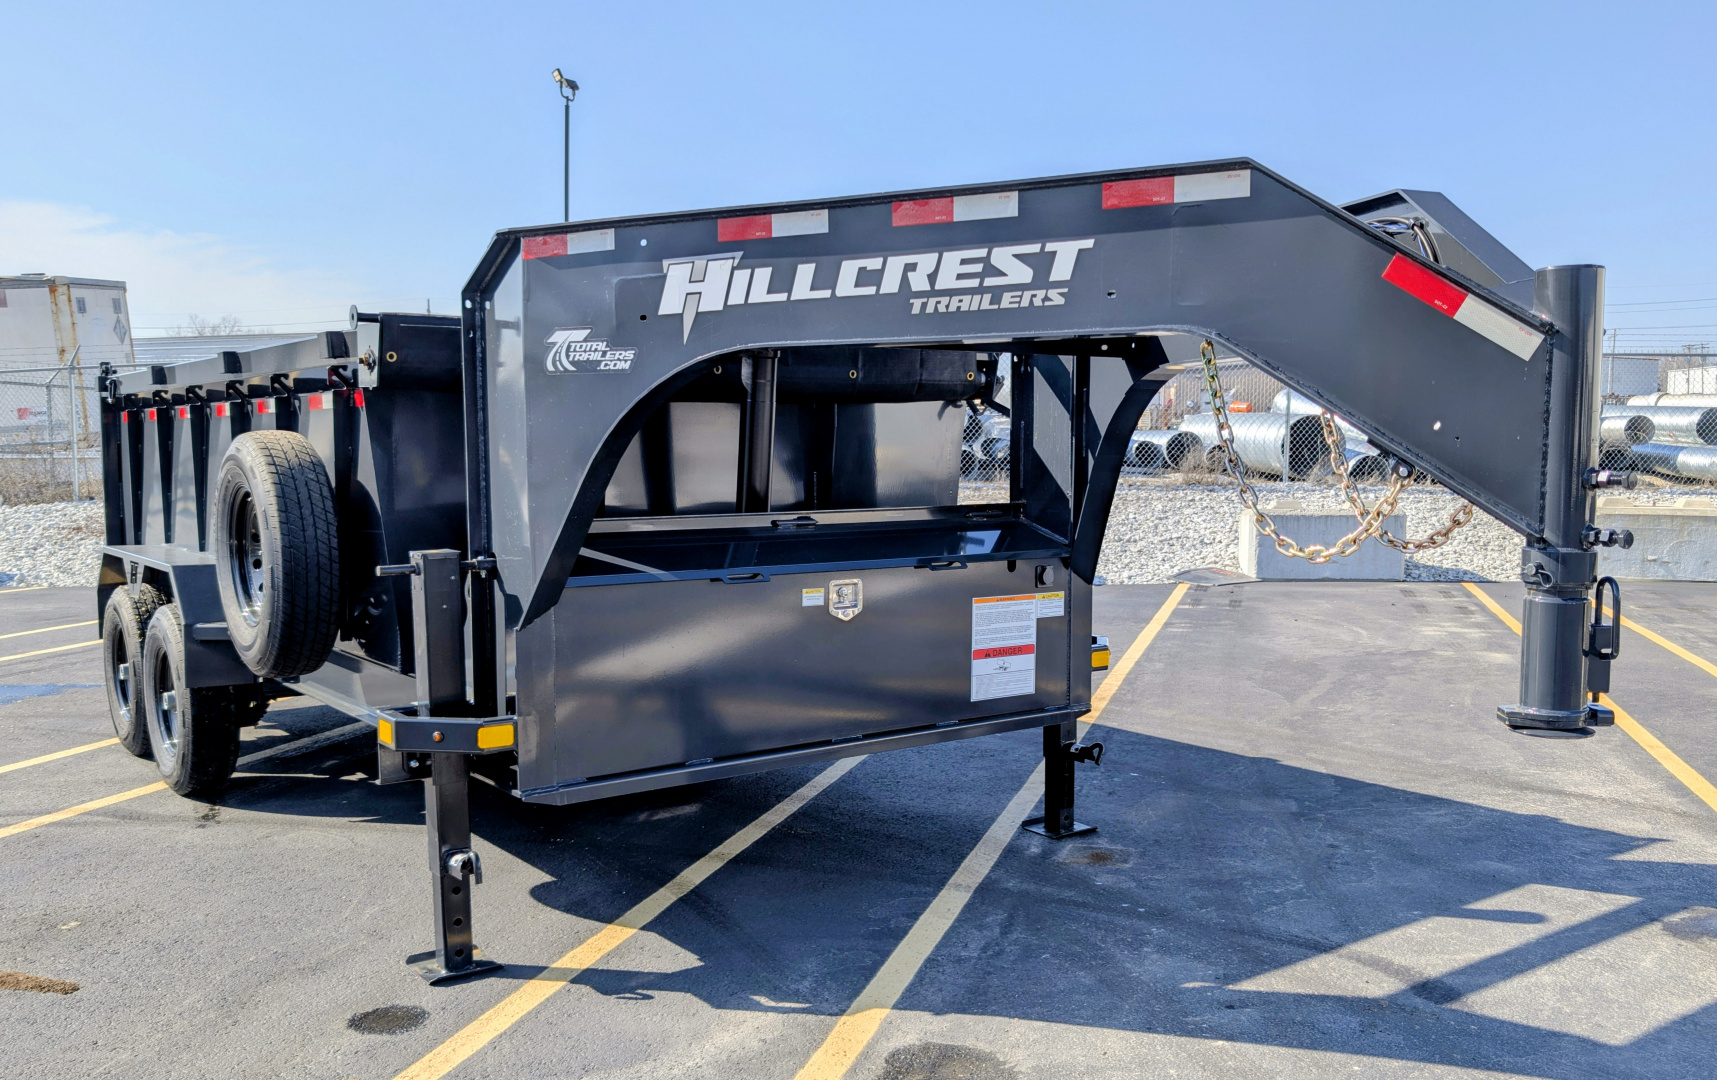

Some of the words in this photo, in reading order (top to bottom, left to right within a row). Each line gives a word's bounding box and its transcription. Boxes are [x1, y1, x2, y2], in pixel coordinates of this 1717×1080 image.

[657, 238, 1095, 344] HILLCREST
[909, 287, 1069, 315] TRAILERS
[569, 341, 610, 351] TOTAL
[568, 350, 635, 361] TRAILERS
[597, 360, 632, 370] .COM
[992, 646, 1023, 657] DANGER
